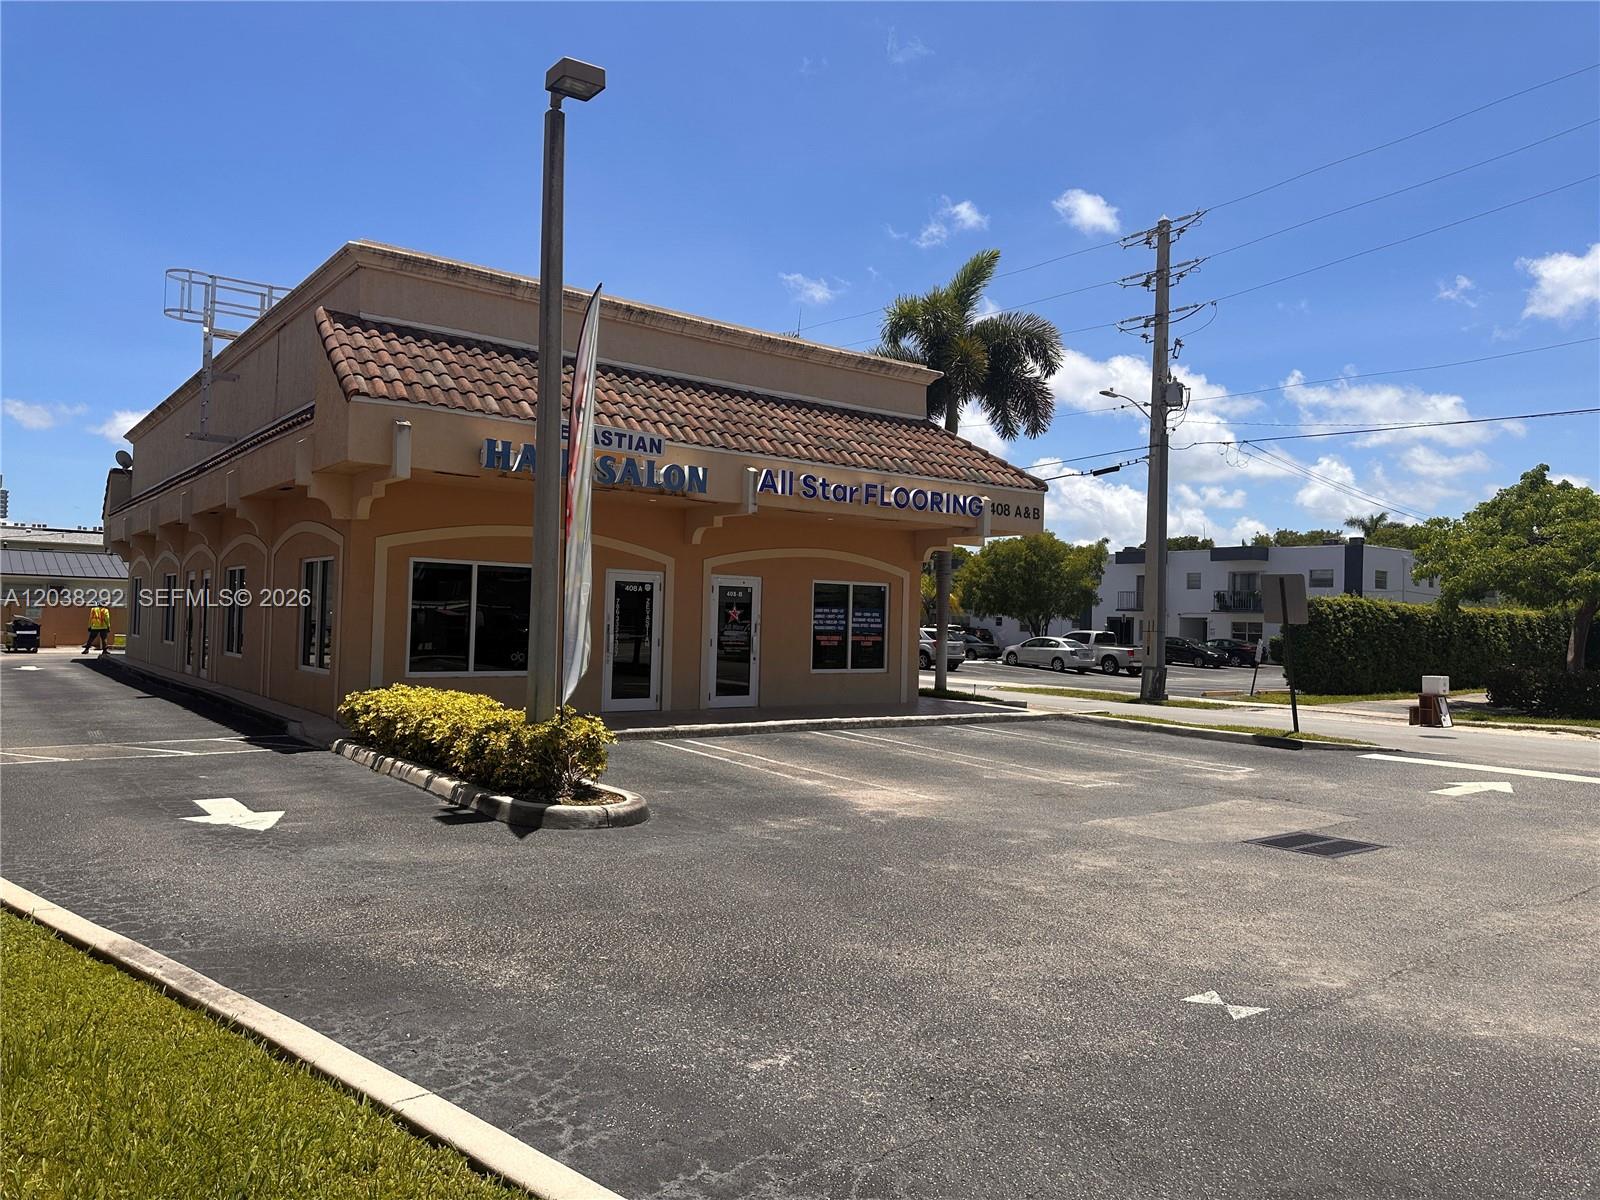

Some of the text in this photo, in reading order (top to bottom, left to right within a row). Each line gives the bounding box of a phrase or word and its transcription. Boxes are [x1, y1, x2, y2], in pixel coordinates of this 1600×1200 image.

[597, 456, 708, 494] SALON
[758, 469, 984, 517] All Star FLOORING
